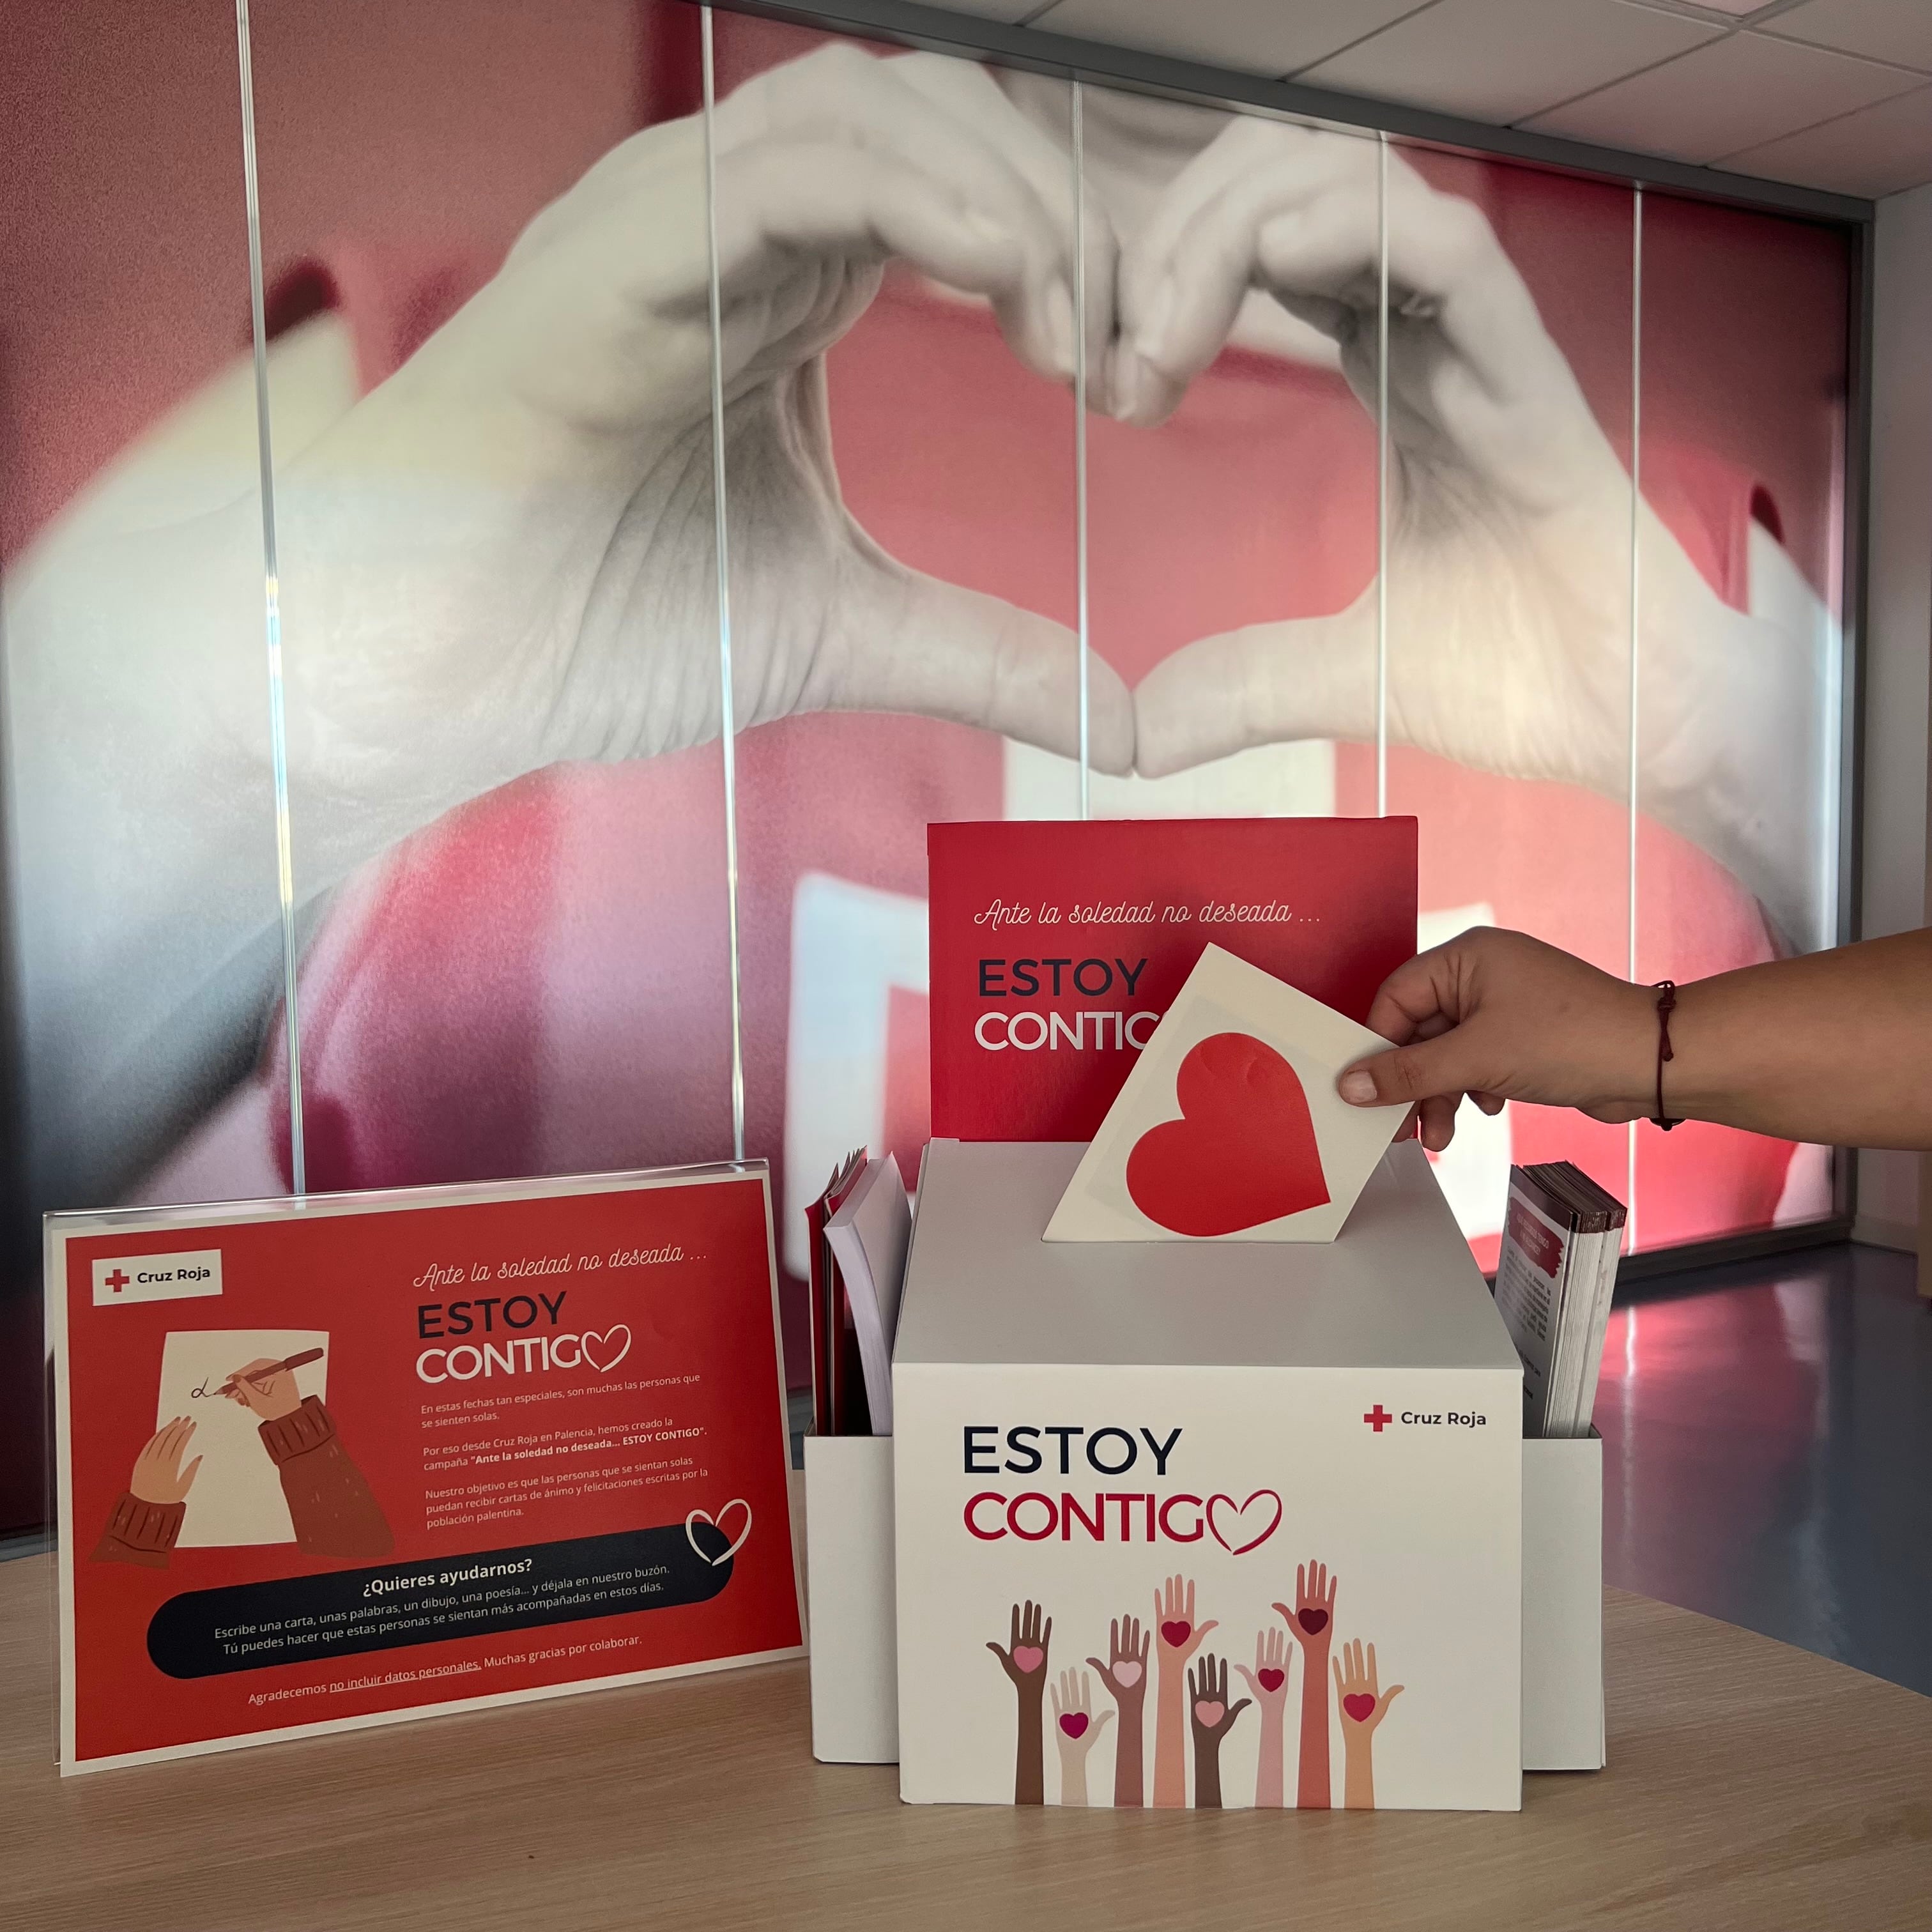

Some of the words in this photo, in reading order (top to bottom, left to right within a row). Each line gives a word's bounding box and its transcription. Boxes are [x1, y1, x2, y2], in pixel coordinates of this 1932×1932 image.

[974, 899, 1032, 931] Ante
[1038, 901, 1062, 924] la
[1068, 901, 1156, 924] soledad
[1161, 906, 1192, 923] no
[1199, 900, 1292, 923] deseada
[979, 958, 1147, 997] ESTOY
[137, 1270, 172, 1284] Cruz
[177, 1266, 210, 1281] Roja
[413, 1263, 465, 1292] Ante
[470, 1262, 491, 1282] la
[497, 1253, 572, 1279] soledad
[577, 1255, 603, 1271] no
[608, 1243, 684, 1268] deseada
[418, 1291, 567, 1339] ESTOY
[421, 1405, 433, 1414] En
[435, 1403, 461, 1413] estas
[463, 1399, 494, 1409] fechas
[496, 1397, 512, 1406] tan
[514, 1390, 565, 1404] especiales,
[567, 1388, 584, 1397] son
[586, 1383, 623, 1395] muchas
[624, 1381, 638, 1390] las
[640, 1376, 681, 1390] personas
[682, 1374, 700, 1385] que
[421, 1420, 433, 1429] se
[434, 1416, 471, 1427] sienten
[473, 1411, 500, 1422] solas.
[423, 1447, 440, 1457] Por
[442, 1445, 459, 1454] eso
[461, 1440, 491, 1452] desde
[493, 1438, 515, 1448] Cruz
[518, 1436, 538, 1446] Roja
[540, 1434, 552, 1442] en
[555, 1429, 595, 1440] Palencia,
[597, 1424, 629, 1434] hemos
[631, 1418, 663, 1430] creado
[664, 1417, 673, 1427] la
[1400, 1411, 1441, 1425] Cruz
[1448, 1411, 1486, 1429] Roja
[424, 1458, 468, 1471] campaña
[502, 1452, 512, 1460] la
[514, 1445, 553, 1459] soledad
[556, 1446, 569, 1454] no
[571, 1439, 620, 1452] deseada...
[622, 1433, 653, 1445] ESTOY
[964, 1426, 1183, 1476] ESTOY
[425, 1487, 464, 1499] Nuestro
[466, 1482, 505, 1495] objetivo
[507, 1480, 519, 1489] es
[520, 1478, 539, 1489] que
[541, 1475, 555, 1484] las
[556, 1469, 600, 1484] personas
[602, 1467, 620, 1478] que
[622, 1466, 632, 1474] se
[634, 1460, 668, 1472] sientan
[670, 1457, 693, 1468] solas
[426, 1501, 463, 1516] puedan
[465, 1497, 496, 1508] recibir
[498, 1493, 528, 1504] cartas
[530, 1490, 542, 1499] de
[544, 1487, 574, 1498] ánimo
[576, 1487, 581, 1496] y
[583, 1478, 643, 1492] felicitaciones
[645, 1473, 680, 1484] escritas
[682, 1471, 698, 1482] por
[700, 1468, 708, 1477] la
[427, 1514, 474, 1531] población
[477, 1508, 524, 1524] palentina.
[363, 1575, 435, 1597] ¿Quieres
[440, 1558, 532, 1586] ayudarnos?
[215, 1624, 256, 1639] Escribe
[259, 1621, 282, 1632] una
[284, 1617, 316, 1629] carta,
[319, 1612, 347, 1623] unas
[350, 1604, 401, 1622] palabras,
[404, 1602, 418, 1611] un
[421, 1597, 459, 1609] dibujo,
[462, 1593, 482, 1603] una
[486, 1585, 529, 1602] poesía...
[532, 1584, 539, 1596] y
[541, 1578, 573, 1593] déjala
[576, 1577, 589, 1586] en
[592, 1571, 632, 1584] nuestro
[634, 1565, 670, 1577] buzón.
[223, 1642, 238, 1655] Tú
[241, 1637, 284, 1655] puedes
[287, 1632, 319, 1645] hacer
[322, 1630, 344, 1642] que
[347, 1625, 376, 1636] estas
[379, 1617, 431, 1635] personas
[433, 1614, 445, 1624] se
[448, 1609, 488, 1621] sientan
[491, 1603, 514, 1616] más
[516, 1593, 591, 1612] acompañadas
[594, 1591, 607, 1600] en
[610, 1586, 638, 1598] estos
[640, 1582, 664, 1593] días.
[248, 1684, 327, 1706] Agradecemos
[329, 1682, 344, 1692] no
[347, 1676, 381, 1690] incluir
[385, 1671, 415, 1685] datos
[484, 1654, 526, 1667] Muchas
[528, 1648, 566, 1664] gracias
[569, 1644, 587, 1657] por
[589, 1636, 642, 1652] colaborar.
